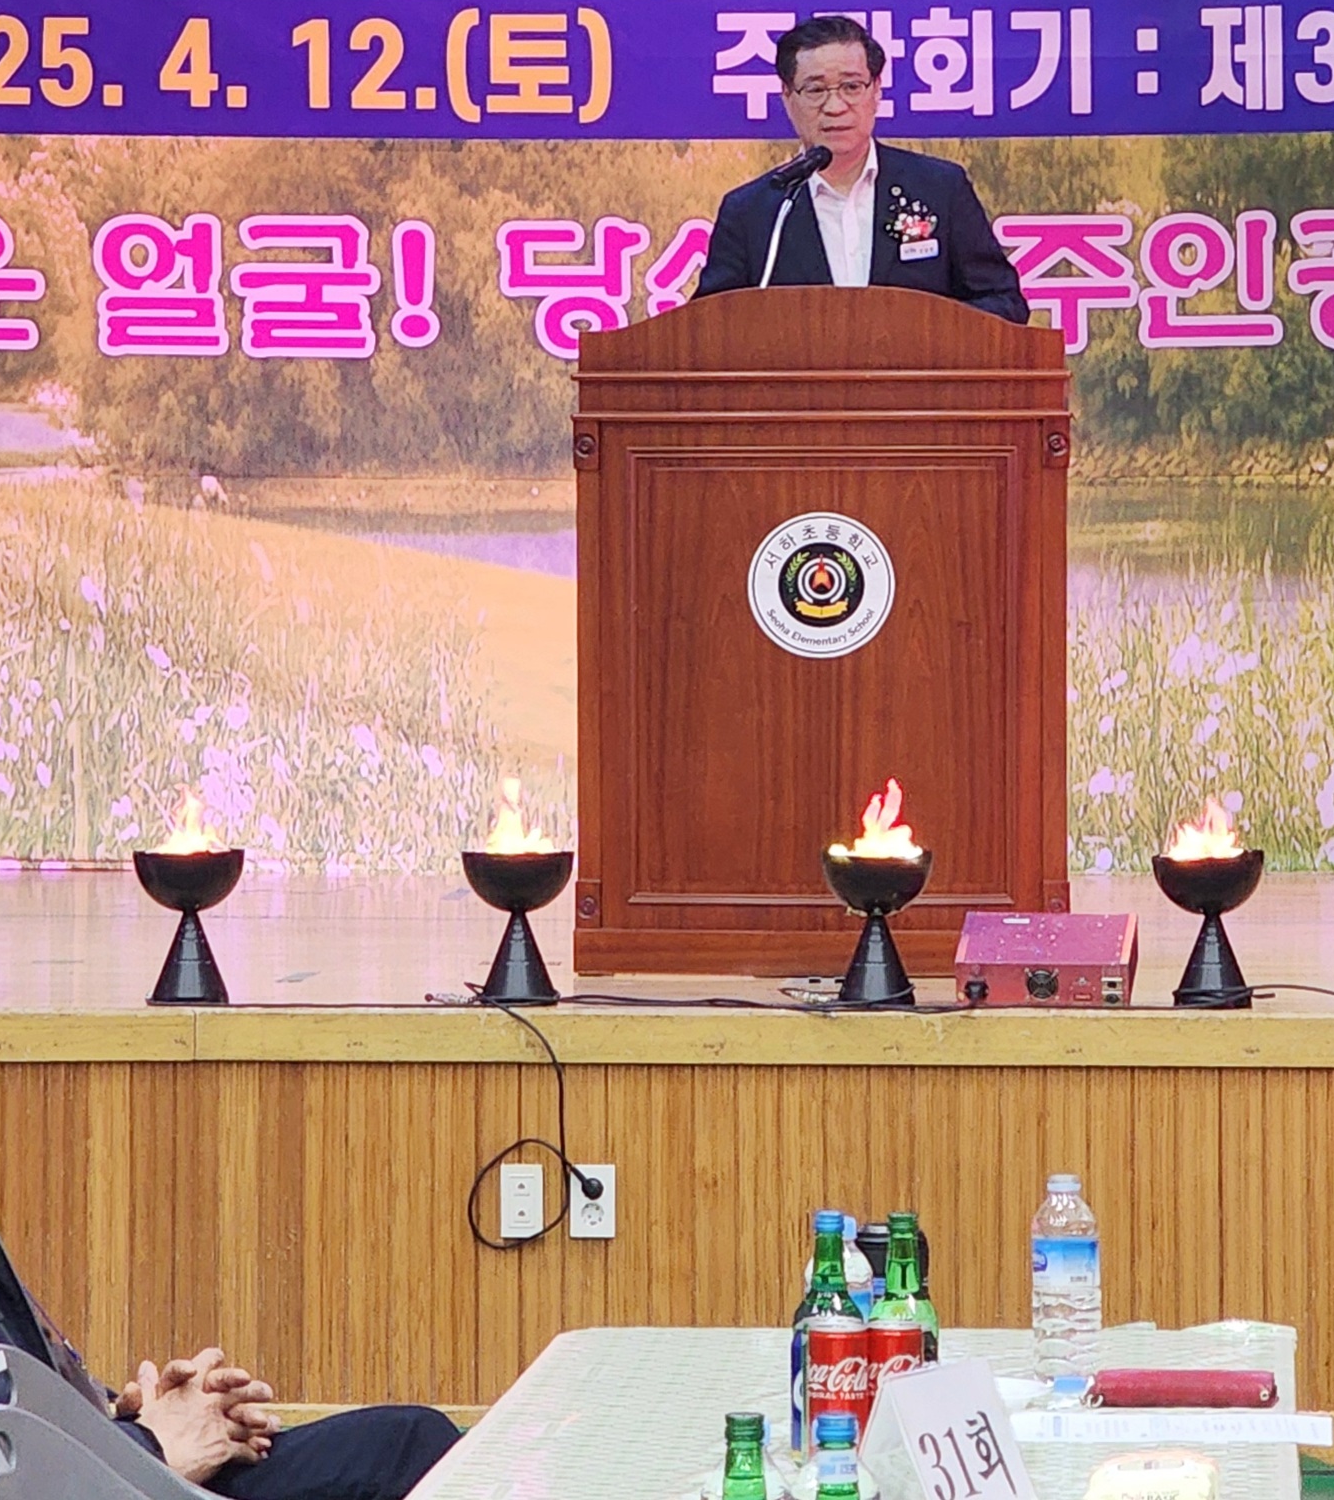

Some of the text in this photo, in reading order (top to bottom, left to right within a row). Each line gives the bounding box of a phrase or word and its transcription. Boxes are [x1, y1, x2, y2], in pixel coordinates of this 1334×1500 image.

[159, 17, 247, 108] 4.
[292, 7, 611, 124] 12.(토)
[99, 219, 433, 353] 얼굴!
[764, 524, 879, 570] 서하초등학교
[766, 608, 875, 646] Seoha Elementary School
[918, 1410, 1018, 1500] 31회
